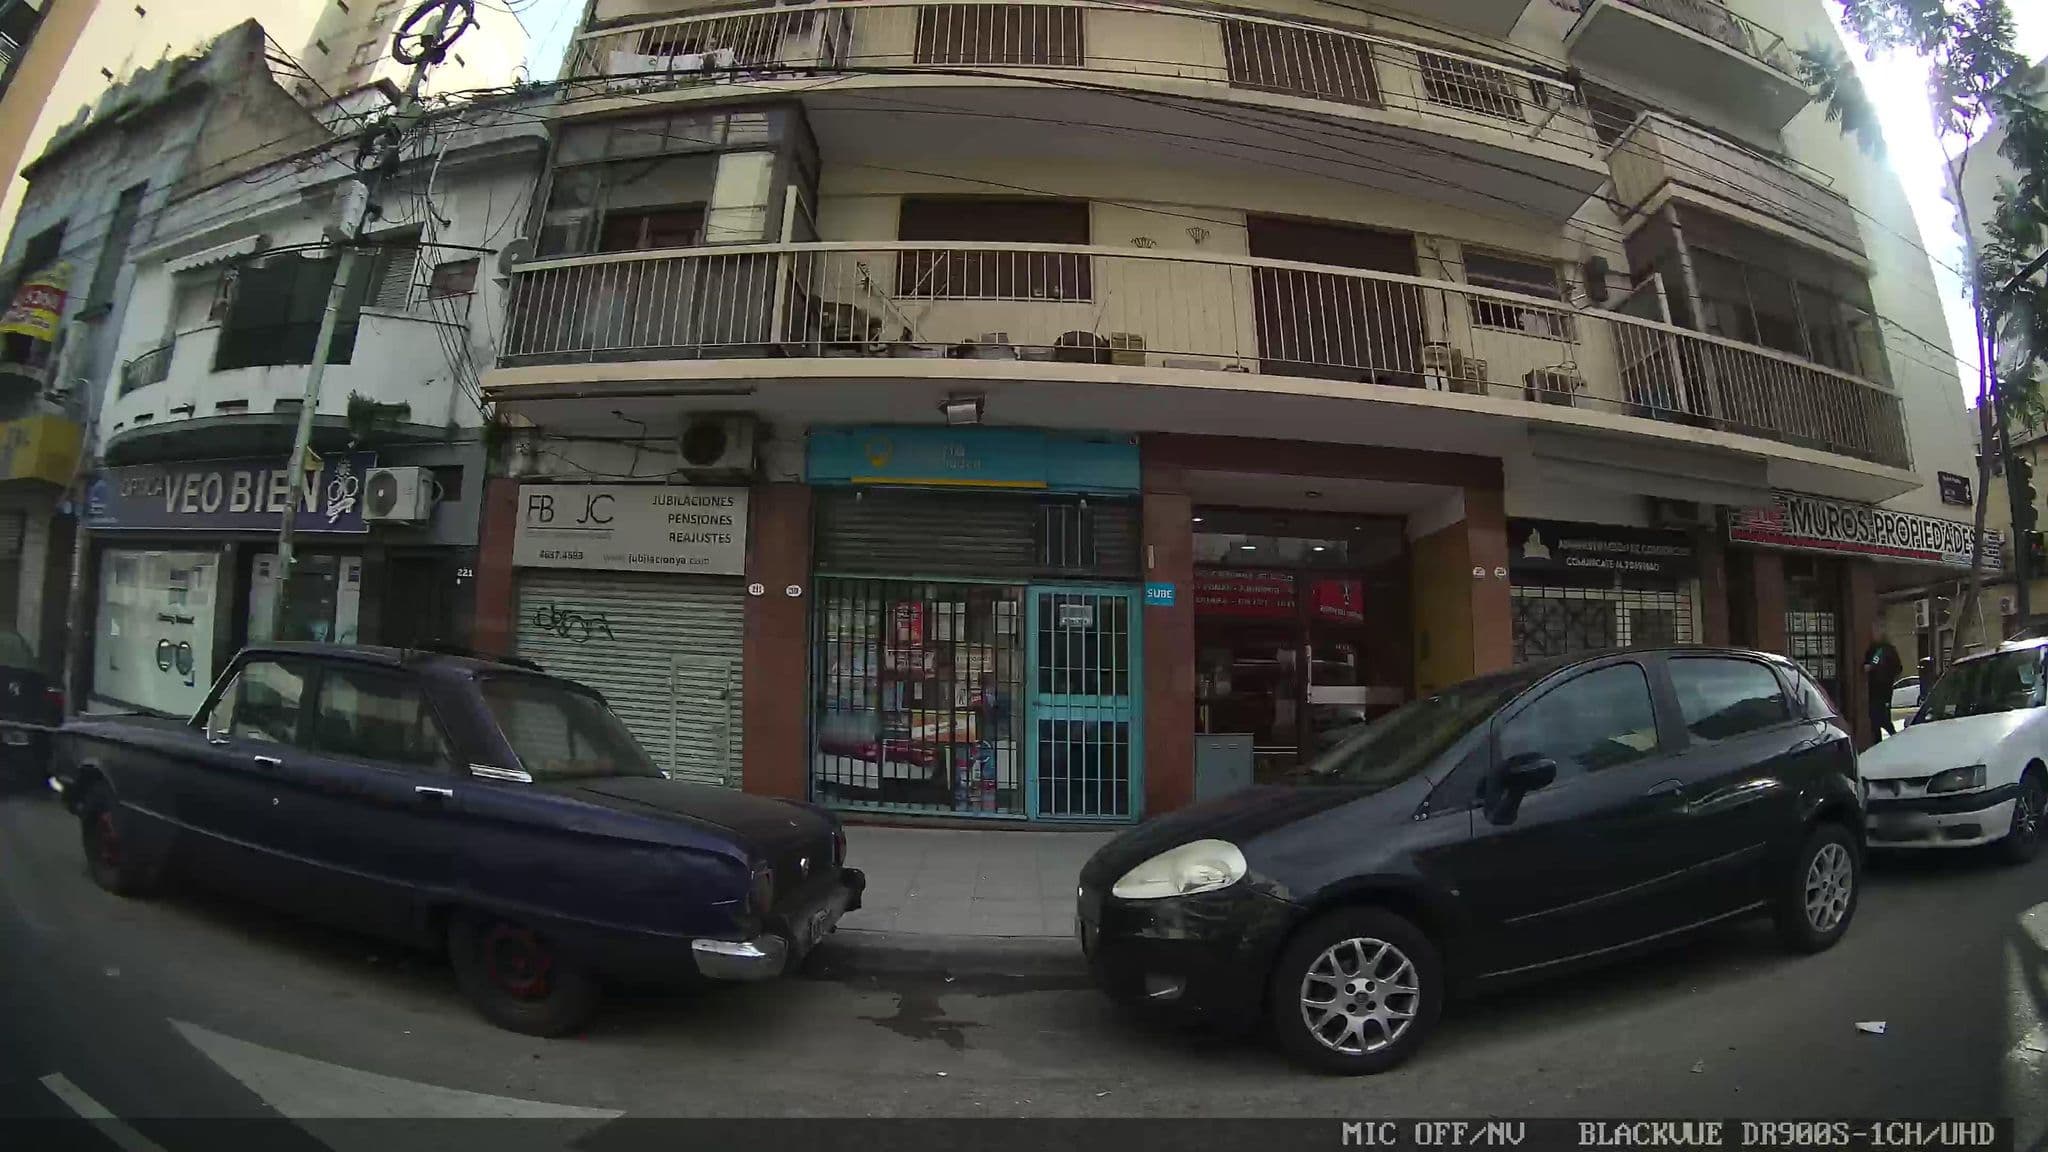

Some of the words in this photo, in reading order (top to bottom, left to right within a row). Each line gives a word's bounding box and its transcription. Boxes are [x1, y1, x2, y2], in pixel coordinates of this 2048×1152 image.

[164, 471, 223, 514] VEO
[229, 469, 321, 514] BIEN
[652, 495, 735, 507] JUBILACIONES
[527, 494, 555, 523] FB
[576, 494, 616, 524] JC
[667, 513, 733, 526] PENSIONES
[1787, 498, 1870, 542] MUROS
[1871, 511, 1977, 555] PROPIEDADES
[668, 532, 732, 544] REAJUSTES
[457, 568, 473, 577] 221
[1147, 588, 1173, 599] SUBE
